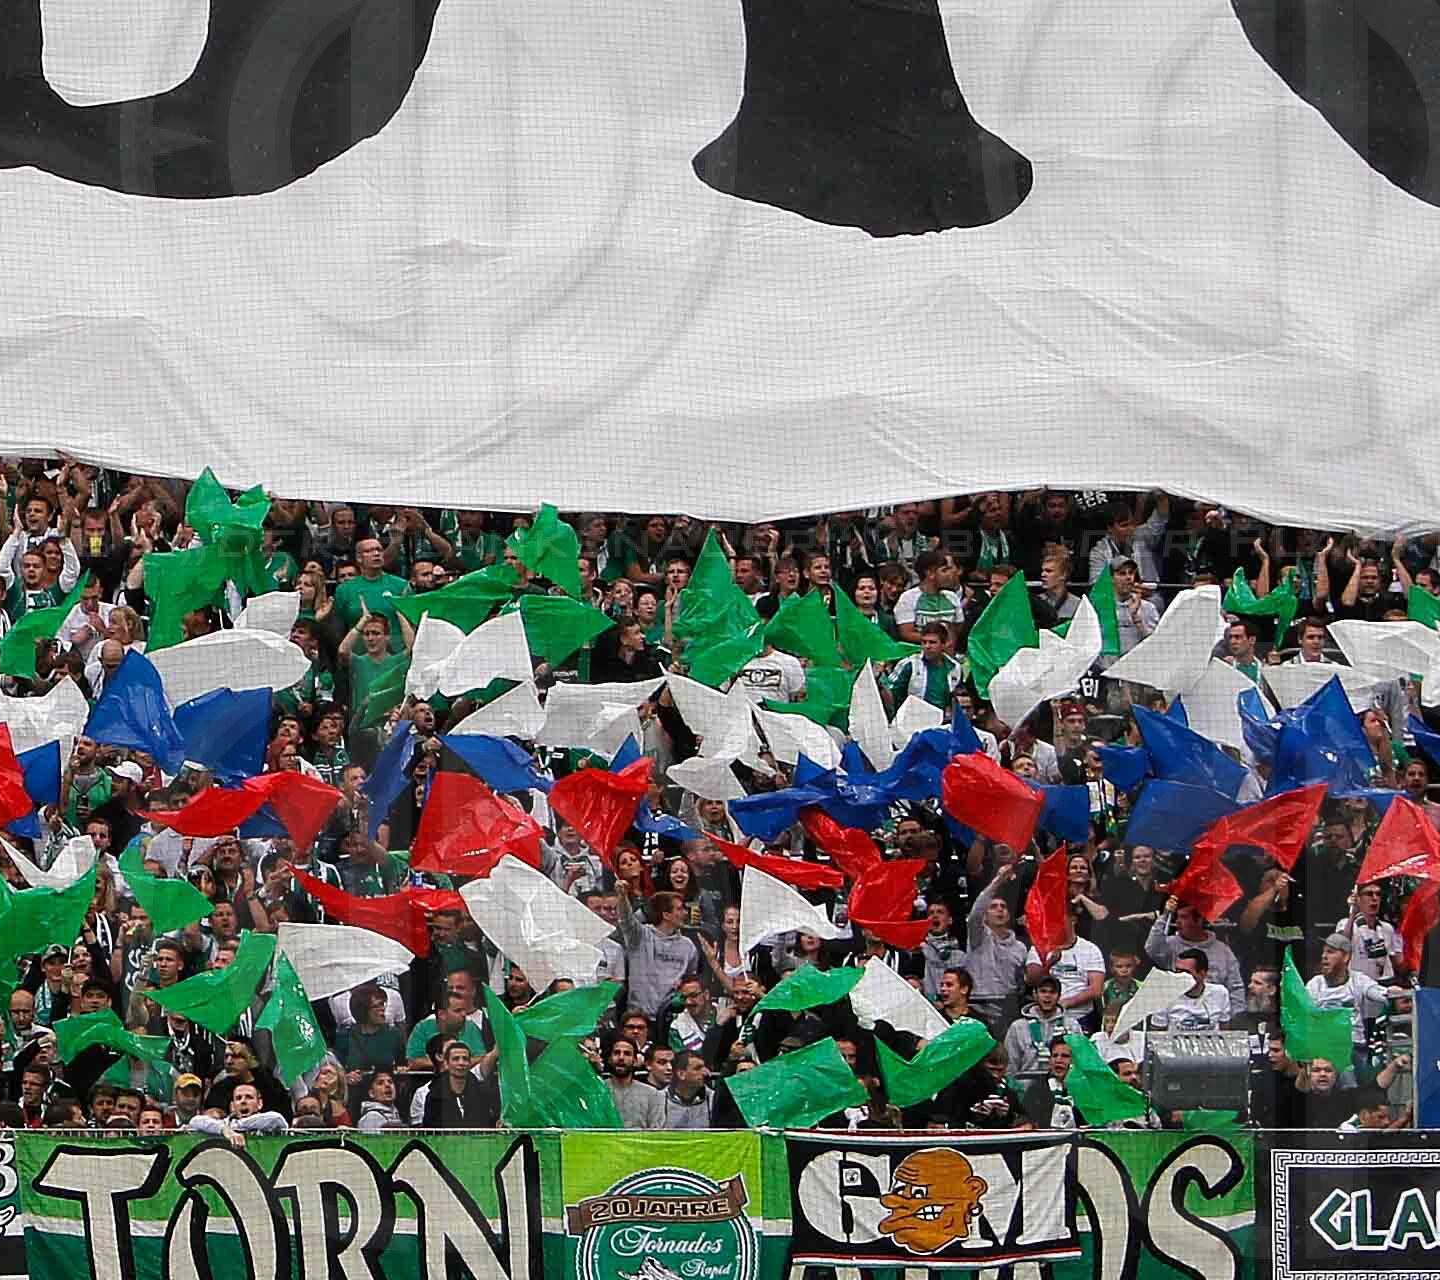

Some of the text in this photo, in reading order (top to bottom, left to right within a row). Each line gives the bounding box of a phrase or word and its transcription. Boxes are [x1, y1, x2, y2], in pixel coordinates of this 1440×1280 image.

[591, 1198, 730, 1222] 20 JAHRE
[610, 1225, 723, 1257] Tornados
[680, 1258, 732, 1279] Rapid
